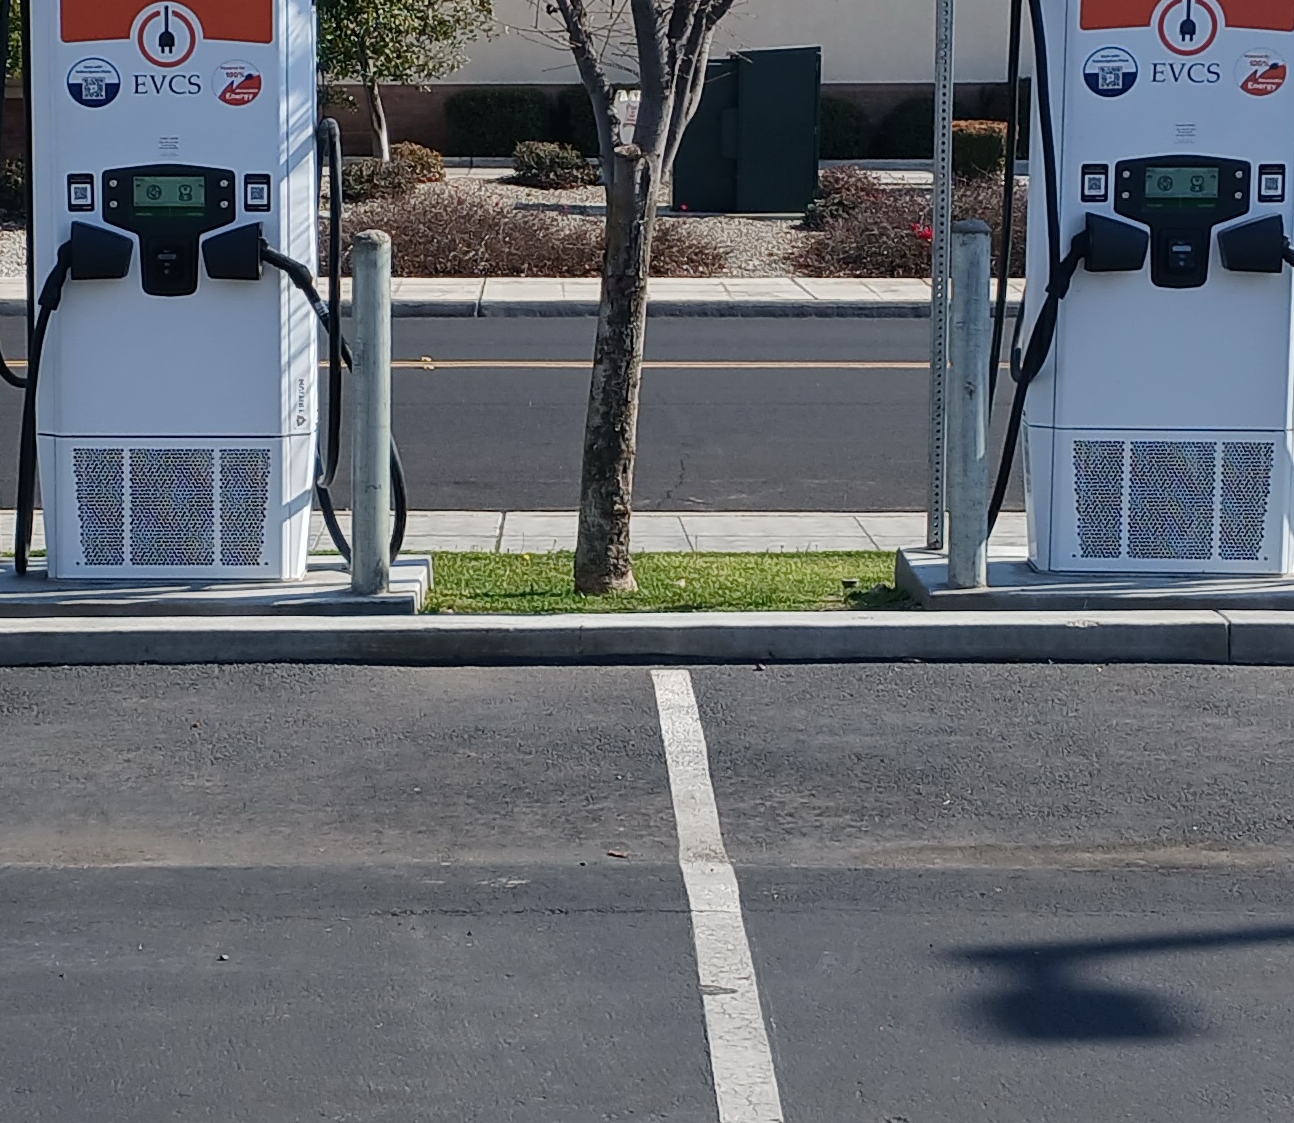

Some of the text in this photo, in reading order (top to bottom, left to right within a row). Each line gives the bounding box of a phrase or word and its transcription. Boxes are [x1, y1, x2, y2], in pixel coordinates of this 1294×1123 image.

[1150, 62, 1221, 83] EVCS
[132, 74, 202, 95] EVCS
[1247, 81, 1277, 92] Energy
[225, 92, 254, 101] Energy
